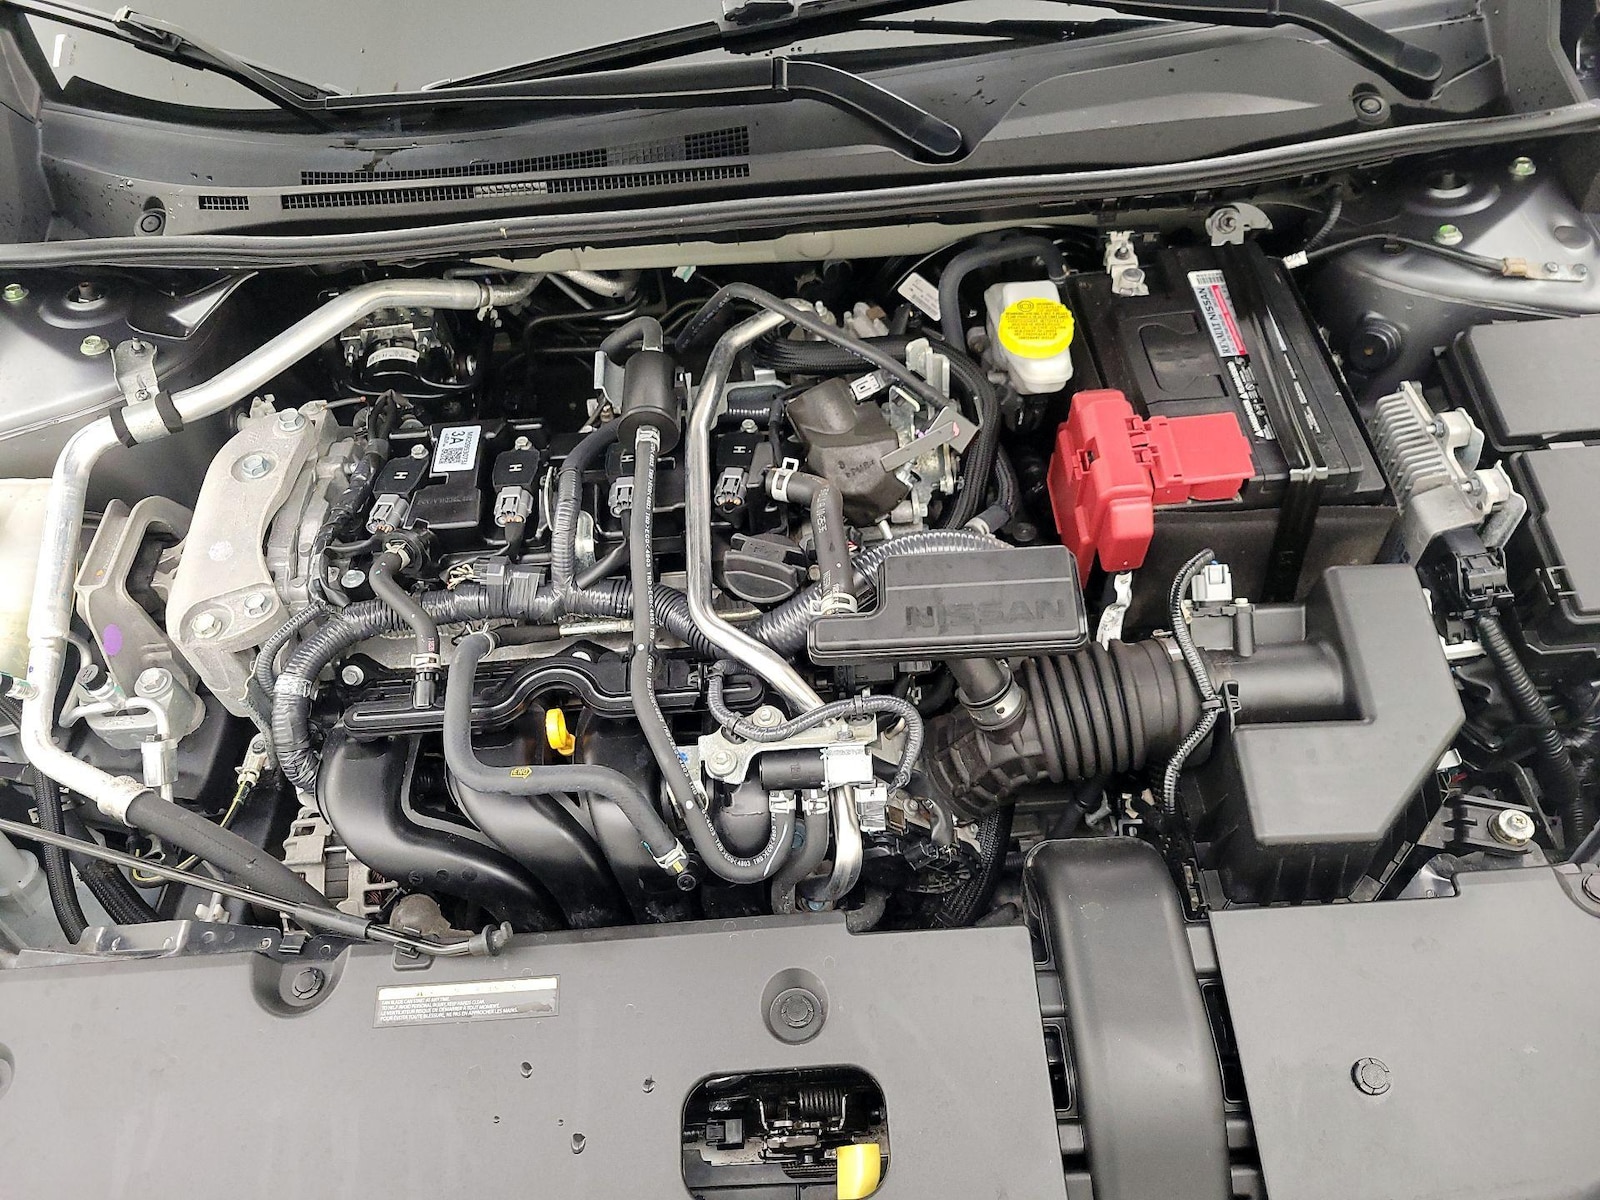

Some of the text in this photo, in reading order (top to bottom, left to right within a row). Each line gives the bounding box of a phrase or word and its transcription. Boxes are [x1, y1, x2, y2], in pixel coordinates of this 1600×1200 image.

[1197, 286, 1218, 320] NISSAN
[449, 430, 466, 445] 3A
[905, 598, 1066, 629] NISSAN
